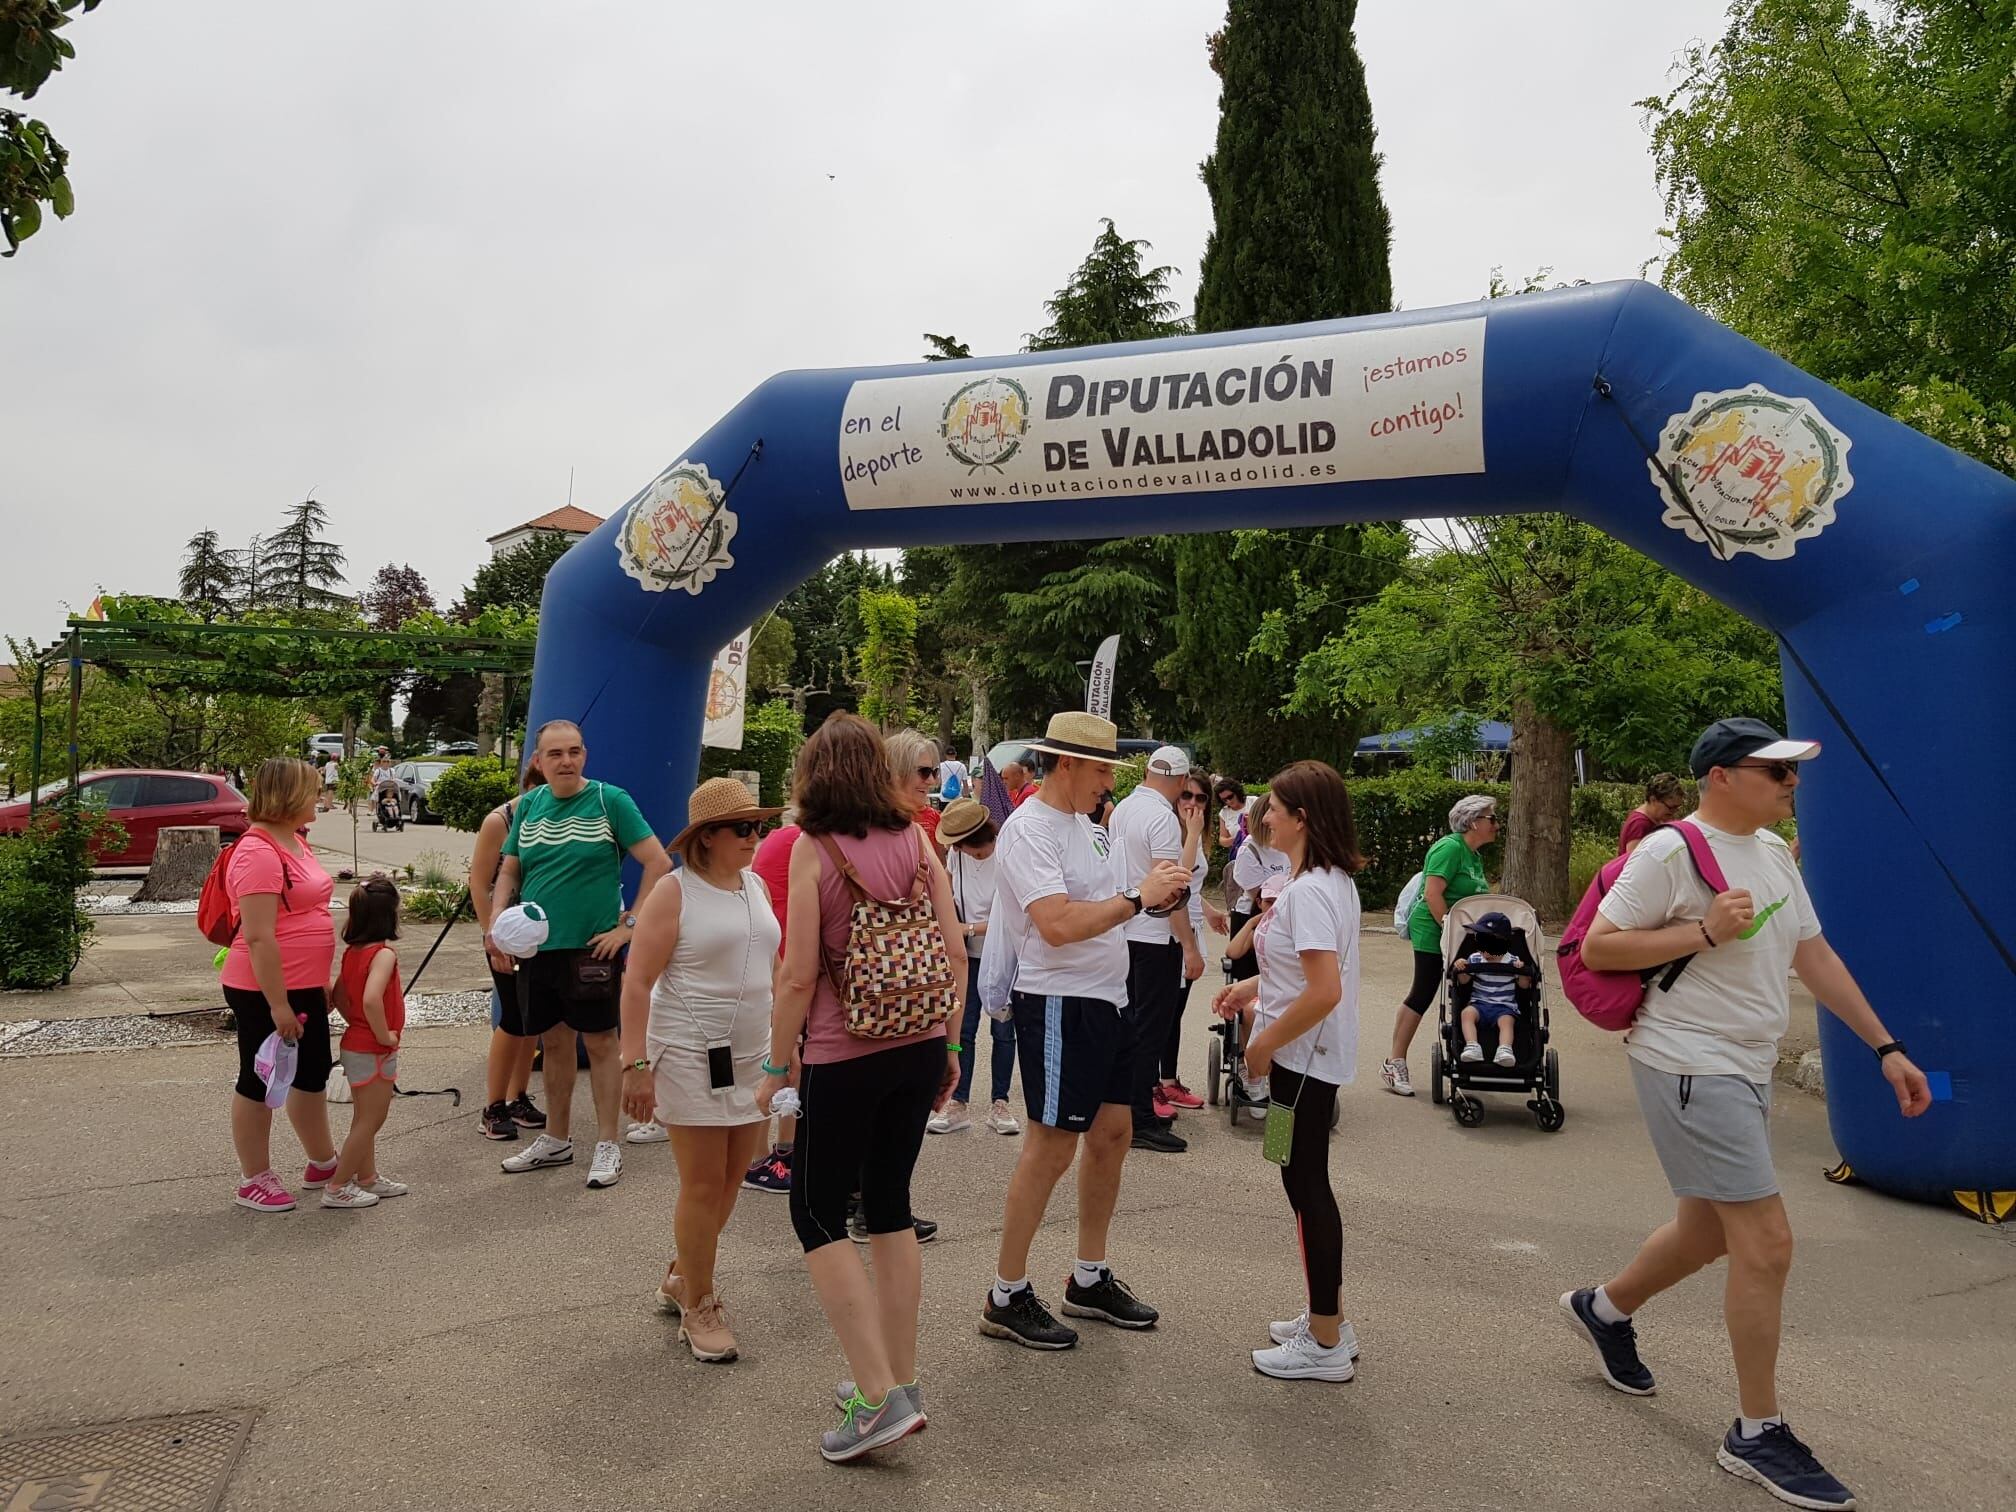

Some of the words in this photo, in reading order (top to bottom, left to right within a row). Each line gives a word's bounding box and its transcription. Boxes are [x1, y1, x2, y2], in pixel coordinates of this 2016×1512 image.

[1045, 355, 1334, 420] DIPUTACIÓN
[1363, 347, 1467, 392] ¡estamos
[845, 416, 871, 434] en
[881, 405, 901, 432] el
[1370, 391, 1464, 437] contigo!
[844, 442, 923, 486] deporte
[1043, 439, 1090, 472] DE
[1101, 420, 1336, 468] VALLADOLID
[950, 463, 1338, 499] www.diputaciondevalladolid.es
[1090, 661, 1103, 716] IPUTACIÓN
